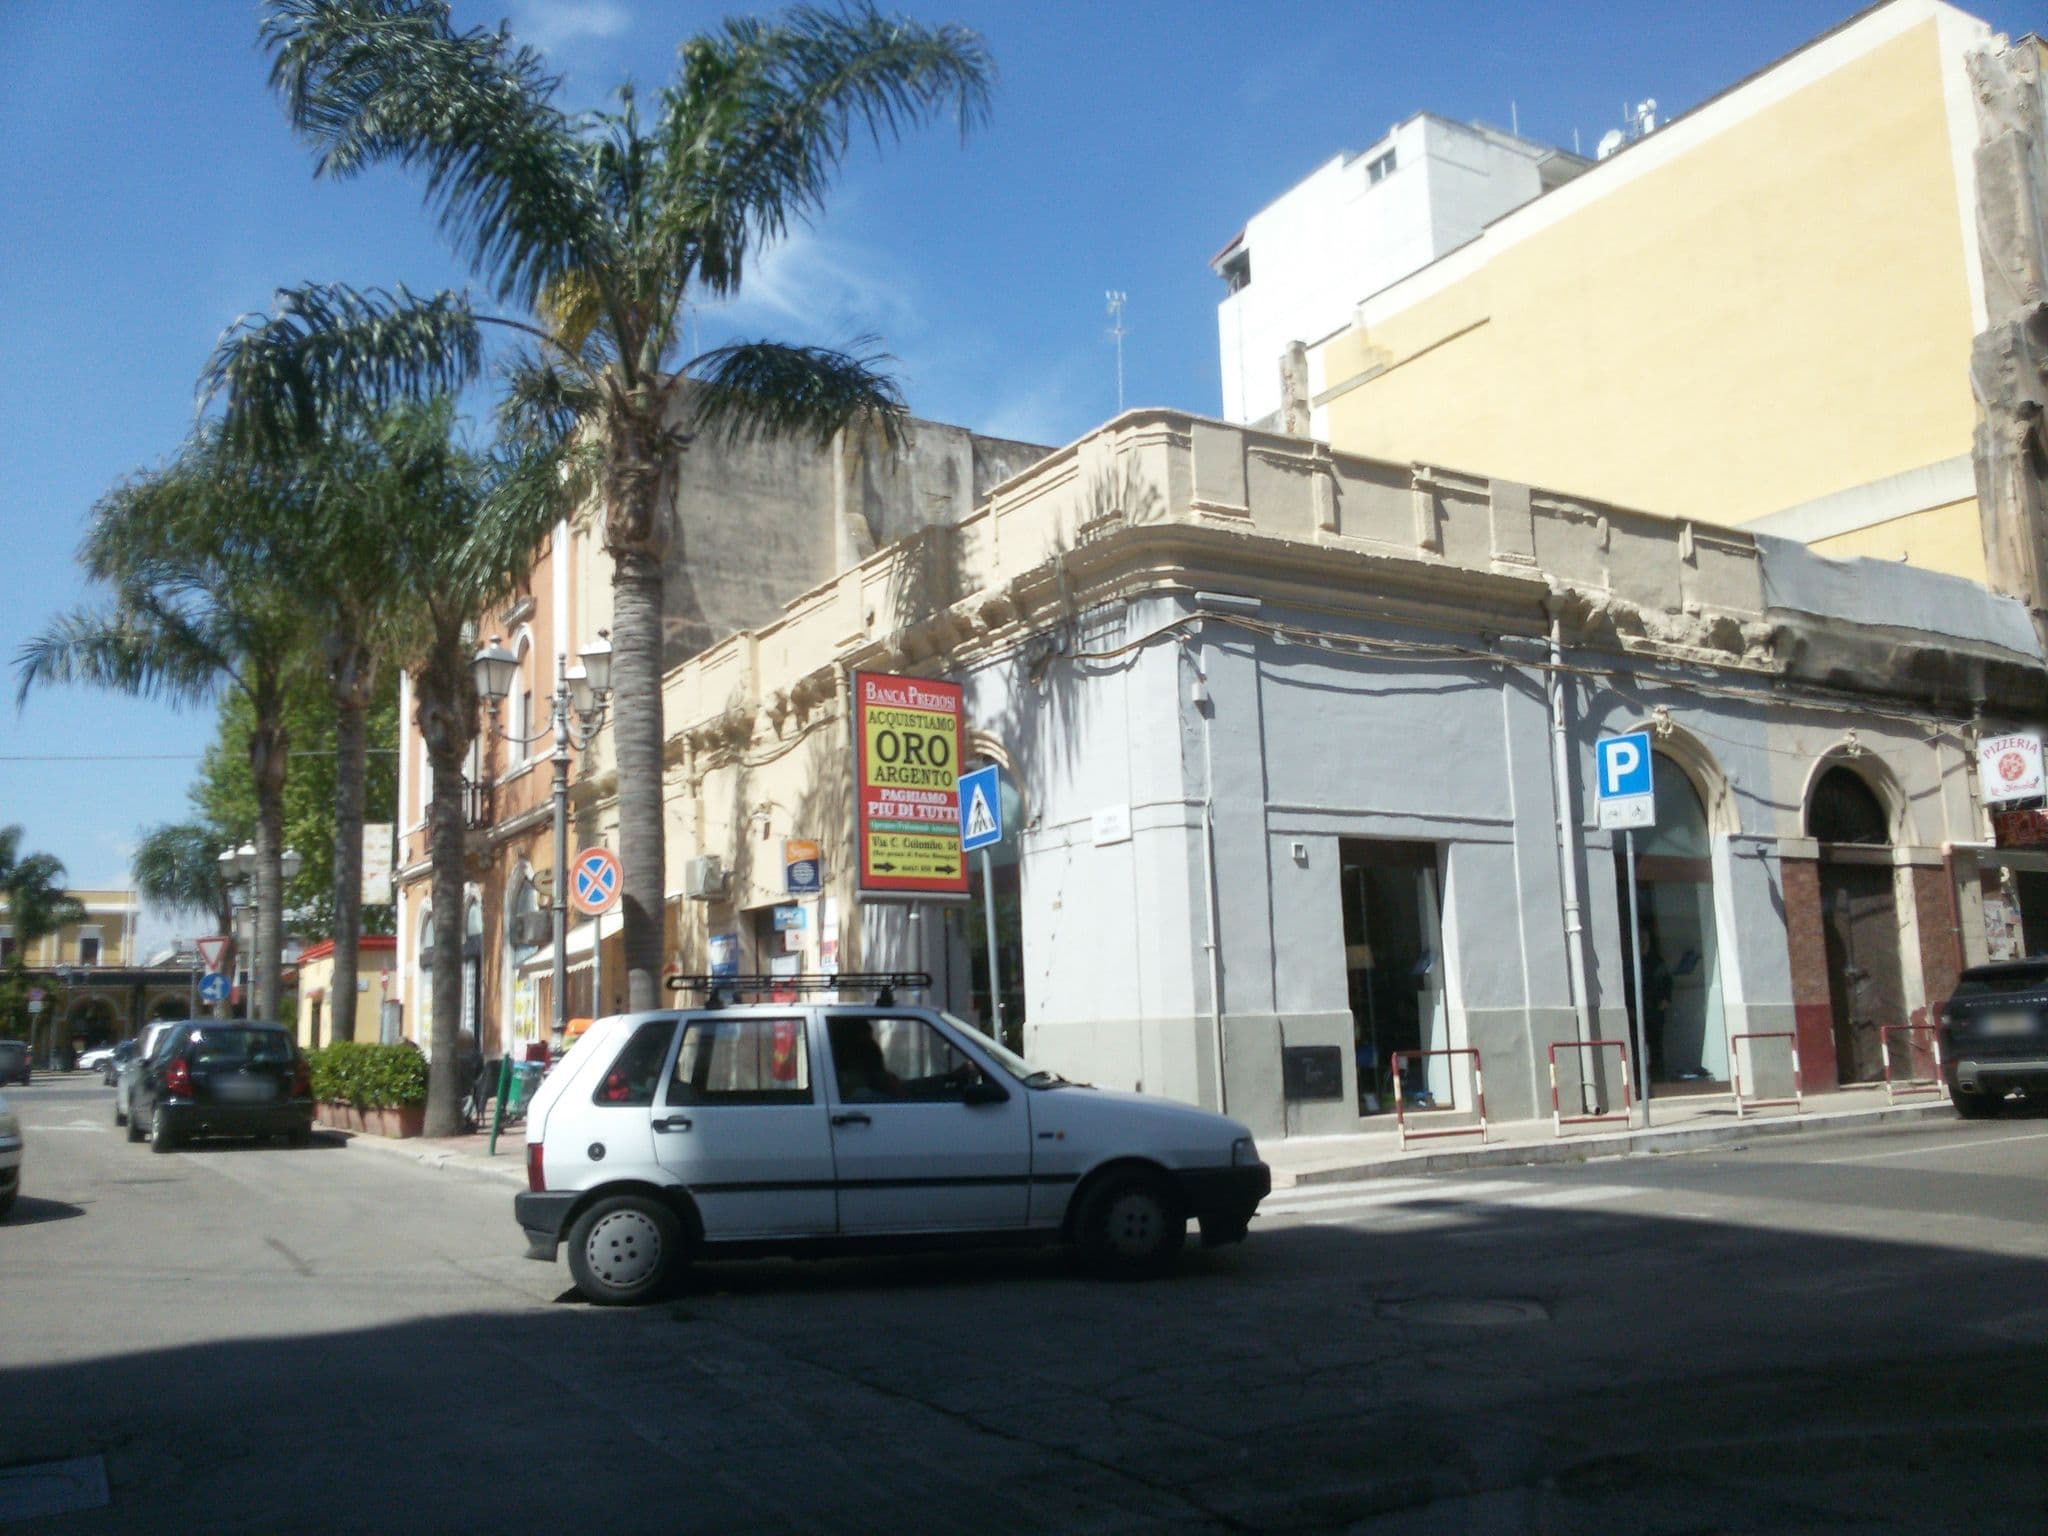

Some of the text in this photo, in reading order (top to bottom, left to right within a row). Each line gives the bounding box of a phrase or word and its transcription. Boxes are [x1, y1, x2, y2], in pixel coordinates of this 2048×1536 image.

[868, 711, 955, 732] ACQUISTIAMO
[876, 729, 950, 768] ORO
[1983, 738, 2038, 760] PIZZERIA
[874, 765, 953, 787] ARGENTO
[1606, 742, 1639, 793] P
[880, 788, 948, 805] PAGHIAMO
[898, 803, 914, 817] DI
[917, 805, 960, 821] TUTTI
